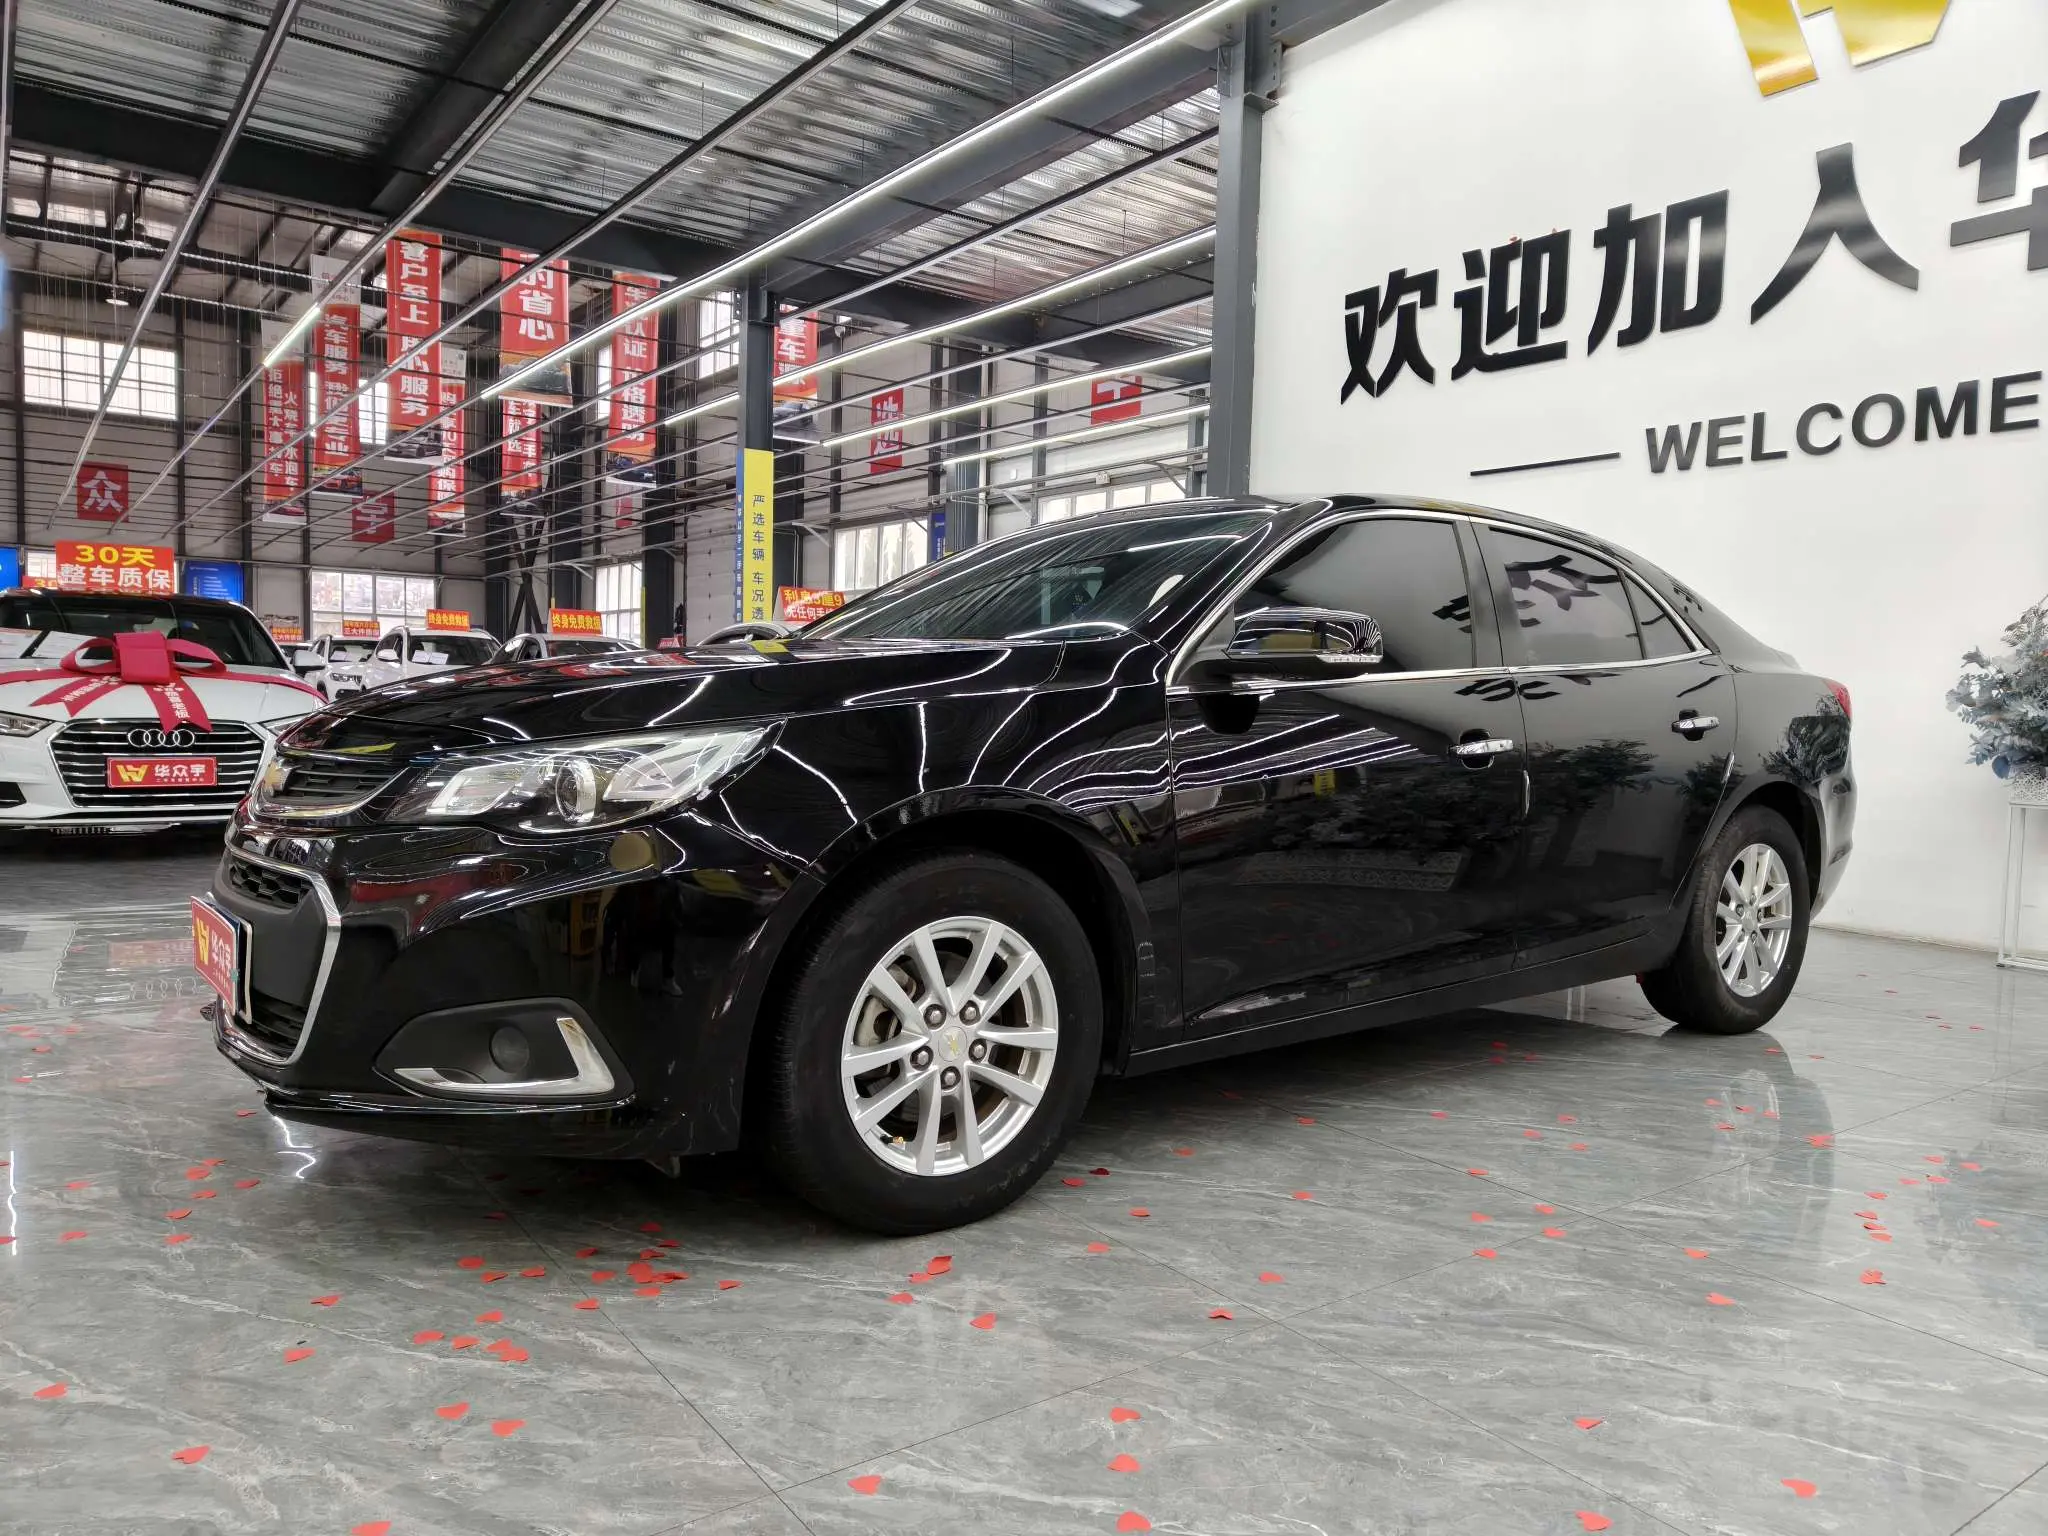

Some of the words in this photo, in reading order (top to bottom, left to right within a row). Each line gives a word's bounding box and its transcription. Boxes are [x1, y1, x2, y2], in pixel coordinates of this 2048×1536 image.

[519, 253, 555, 341] 的省心
[1646, 371, 2042, 474] WELCOME
[82, 471, 122, 513] 众
[75, 545, 155, 568] 30天
[58, 563, 171, 590] 整车质保
[154, 764, 206, 777] 华众宇
